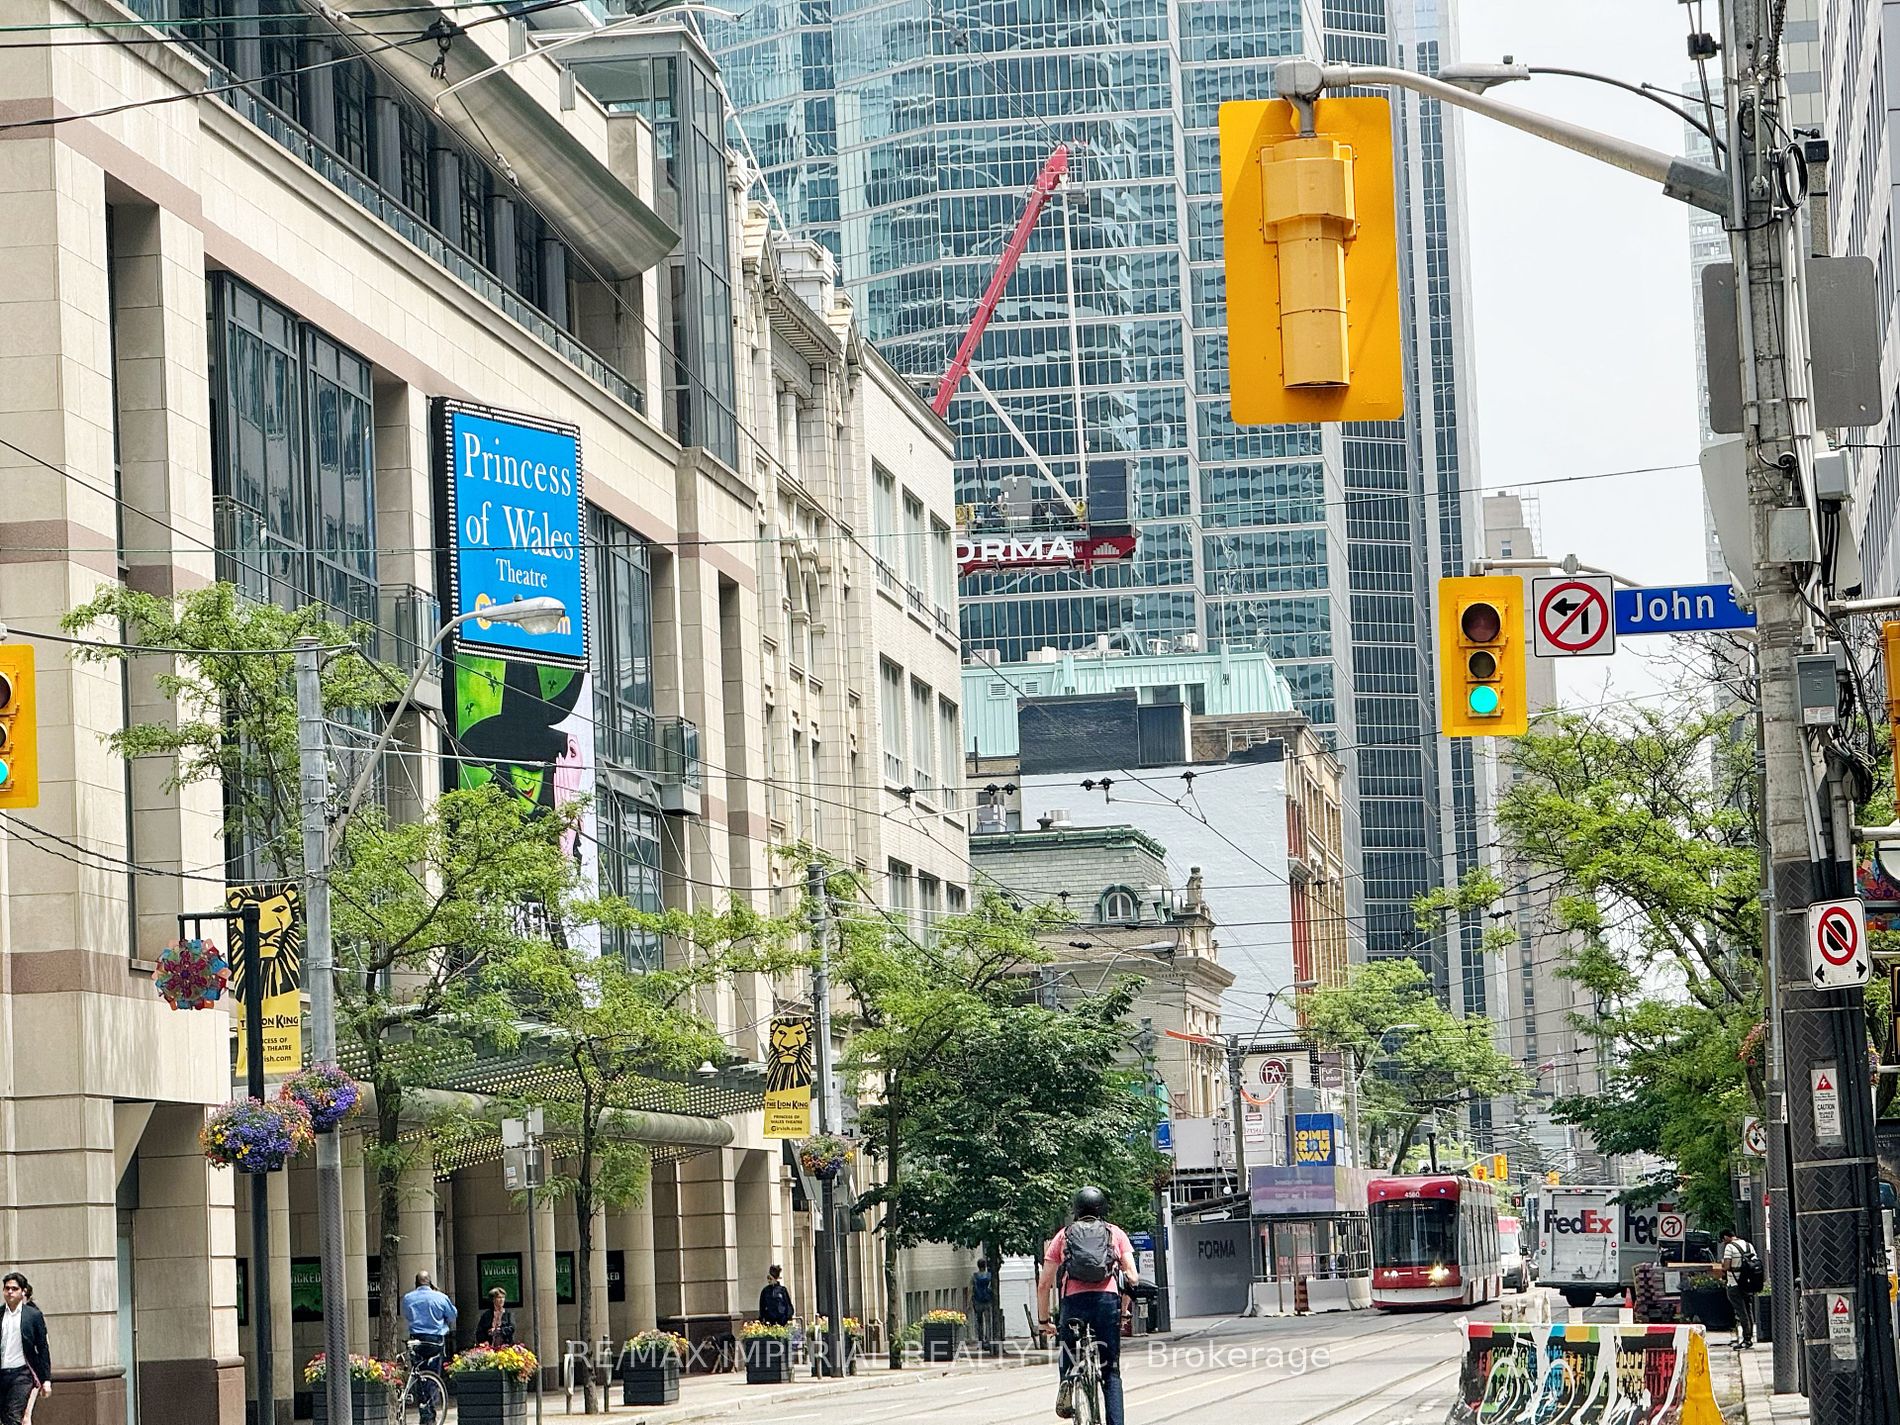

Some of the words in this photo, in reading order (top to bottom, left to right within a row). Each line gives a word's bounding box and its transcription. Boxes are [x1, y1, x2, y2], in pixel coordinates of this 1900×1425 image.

[462, 431, 571, 497] Princess
[465, 500, 492, 546] of
[502, 505, 574, 561] Wales
[956, 535, 1075, 563] ORMA
[495, 558, 548, 589] Theatre
[1630, 590, 1714, 623] John
[1544, 1209, 1613, 1234] FedEx
[1198, 1240, 1236, 1259] FORMA
[292, 1272, 321, 1283] ICKED
[483, 1264, 518, 1276] WICKED
